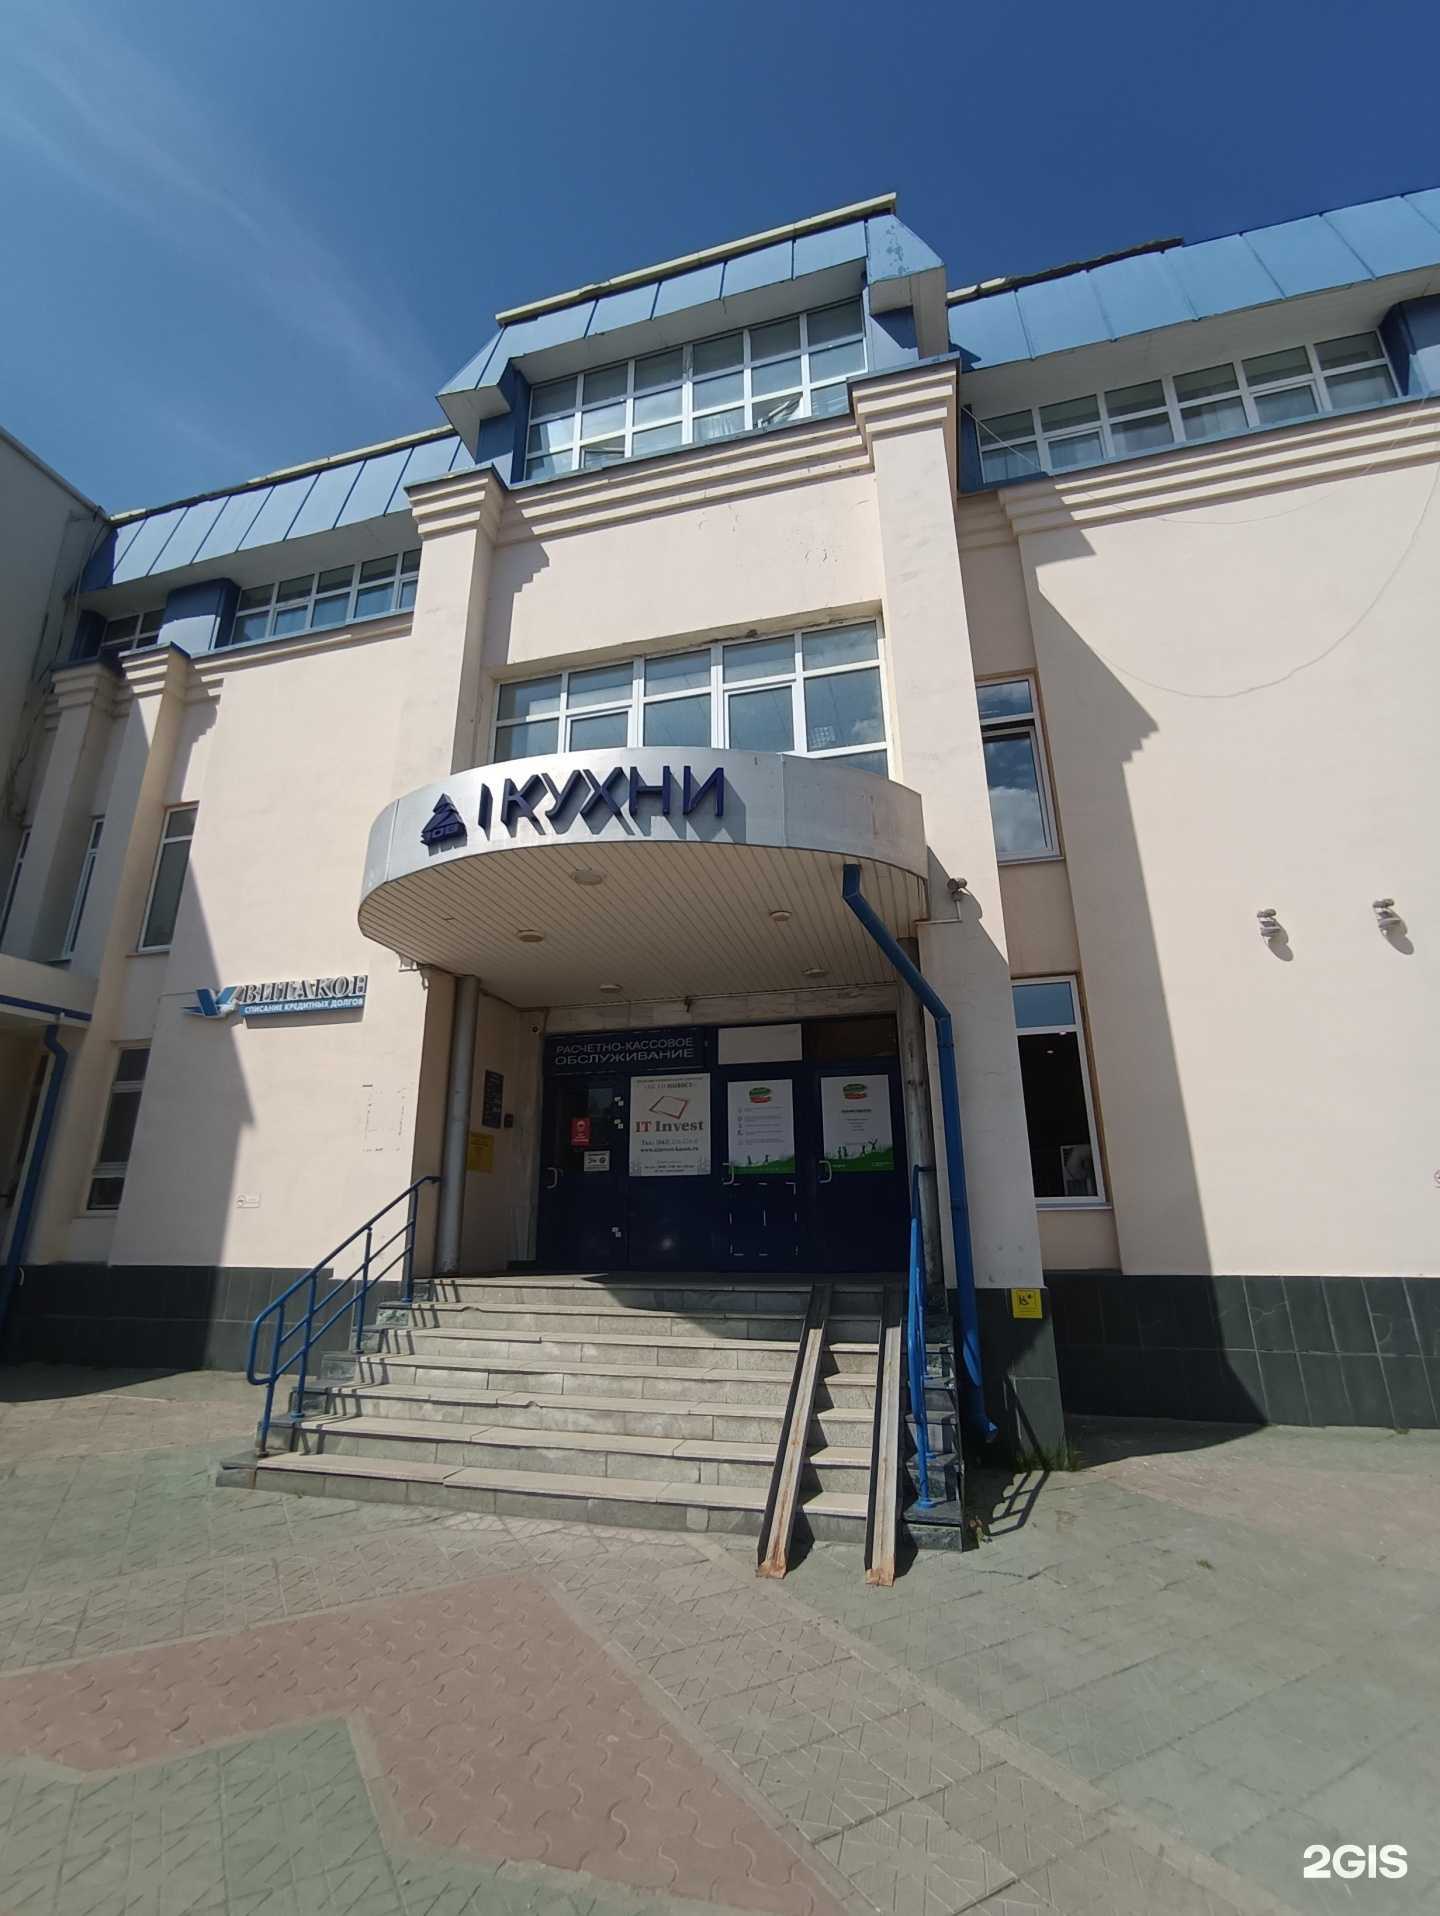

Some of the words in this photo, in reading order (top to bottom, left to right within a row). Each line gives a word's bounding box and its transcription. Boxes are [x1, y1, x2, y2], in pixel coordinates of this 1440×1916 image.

[500, 765, 724, 826] КУХНИ
[241, 975, 368, 1003] ВИТАКОН
[244, 1004, 283, 1014] СПИСАНИЕ
[284, 1000, 329, 1011] КРЕДИТНЫХ
[330, 998, 363, 1008] ДОЛГОВ
[556, 1037, 694, 1054] РАСЧЕТНО-КАССОВОЕ
[555, 1048, 695, 1065] ОБСЛУЖИВАНИЕ
[635, 1121, 652, 1133] IT
[655, 1120, 704, 1132] Invest
